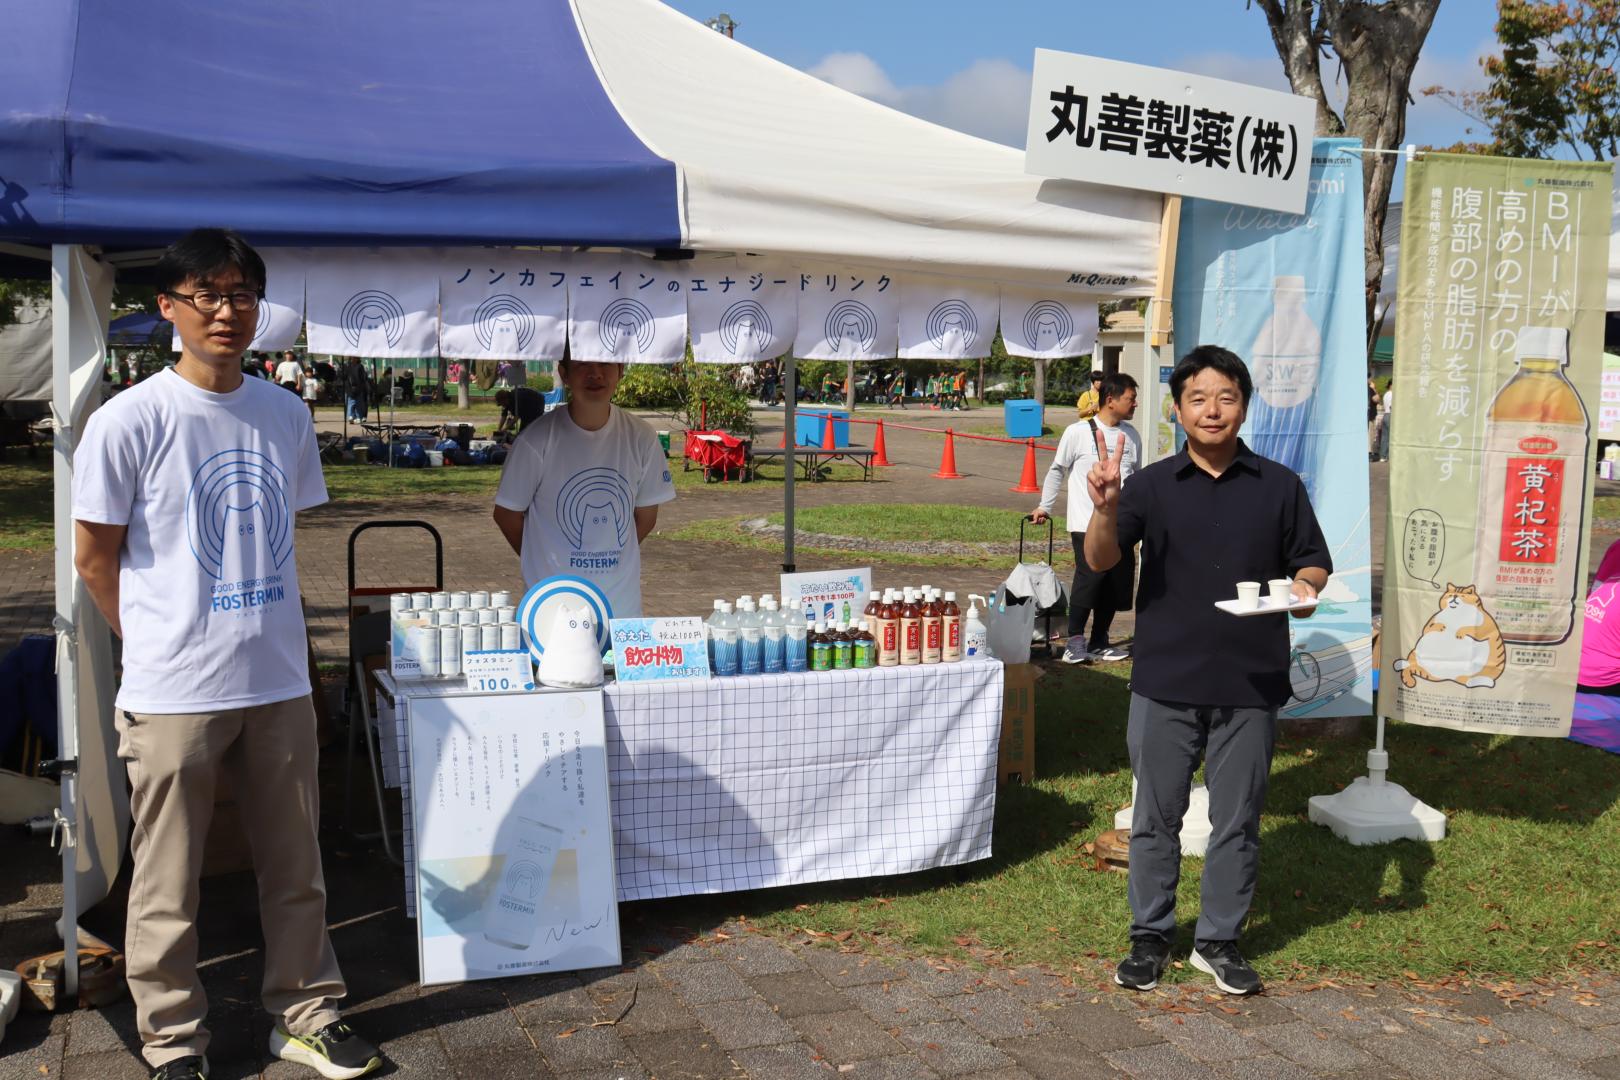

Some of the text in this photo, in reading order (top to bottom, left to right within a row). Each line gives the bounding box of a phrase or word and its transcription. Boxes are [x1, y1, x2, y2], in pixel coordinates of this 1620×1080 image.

[1045, 85, 1298, 180] 丸善製薬(株)
[457, 268, 890, 292] ノンカフェインのエナジードリンク
[1489, 190, 1528, 354] 高めの方の
[1434, 187, 1483, 482] 腹部の脂肪を減らす
[1511, 463, 1552, 559] 黄杞茶
[210, 583, 235, 594] GOOD
[236, 577, 265, 590] ENERGY
[212, 585, 285, 612] FOSTERMIN
[614, 629, 652, 642] 冷えた
[624, 644, 684, 667] 飲み物
